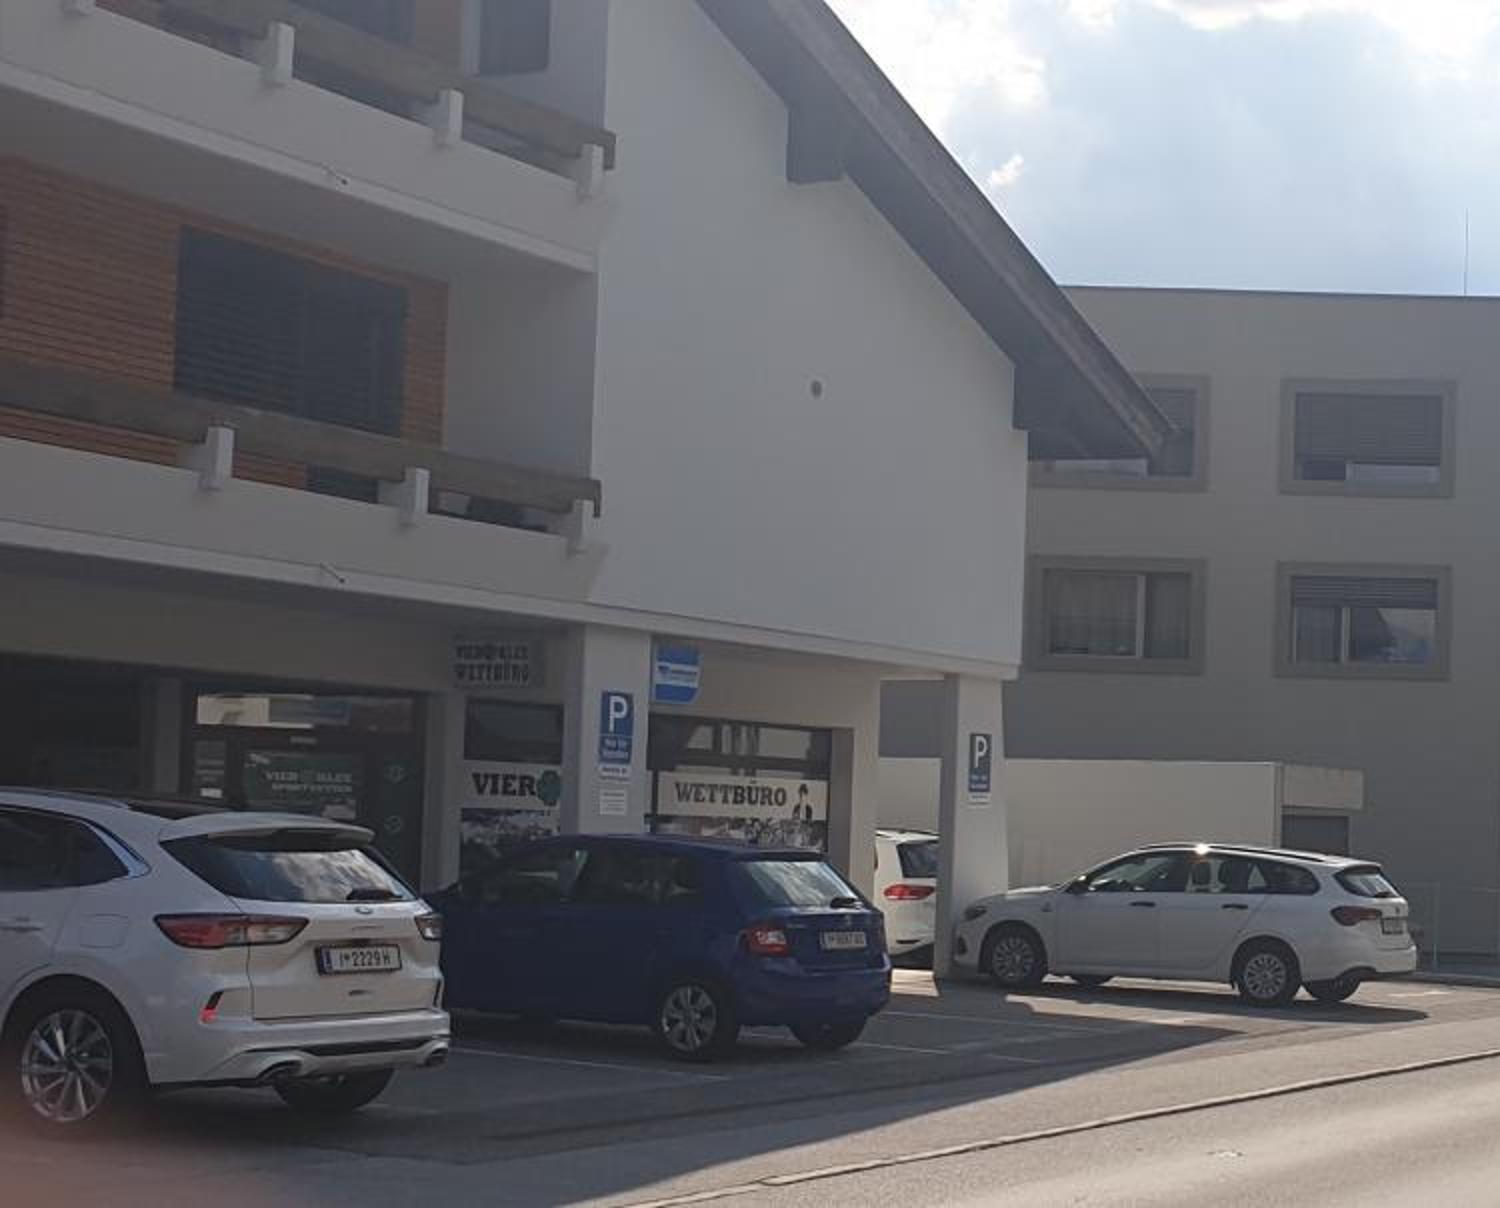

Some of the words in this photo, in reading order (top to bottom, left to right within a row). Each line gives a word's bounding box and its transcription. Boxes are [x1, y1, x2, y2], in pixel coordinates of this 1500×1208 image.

[609, 696, 628, 733] P
[975, 735, 988, 769] P
[472, 772, 537, 797] VIER
[675, 779, 787, 807] WETTBÜRO
